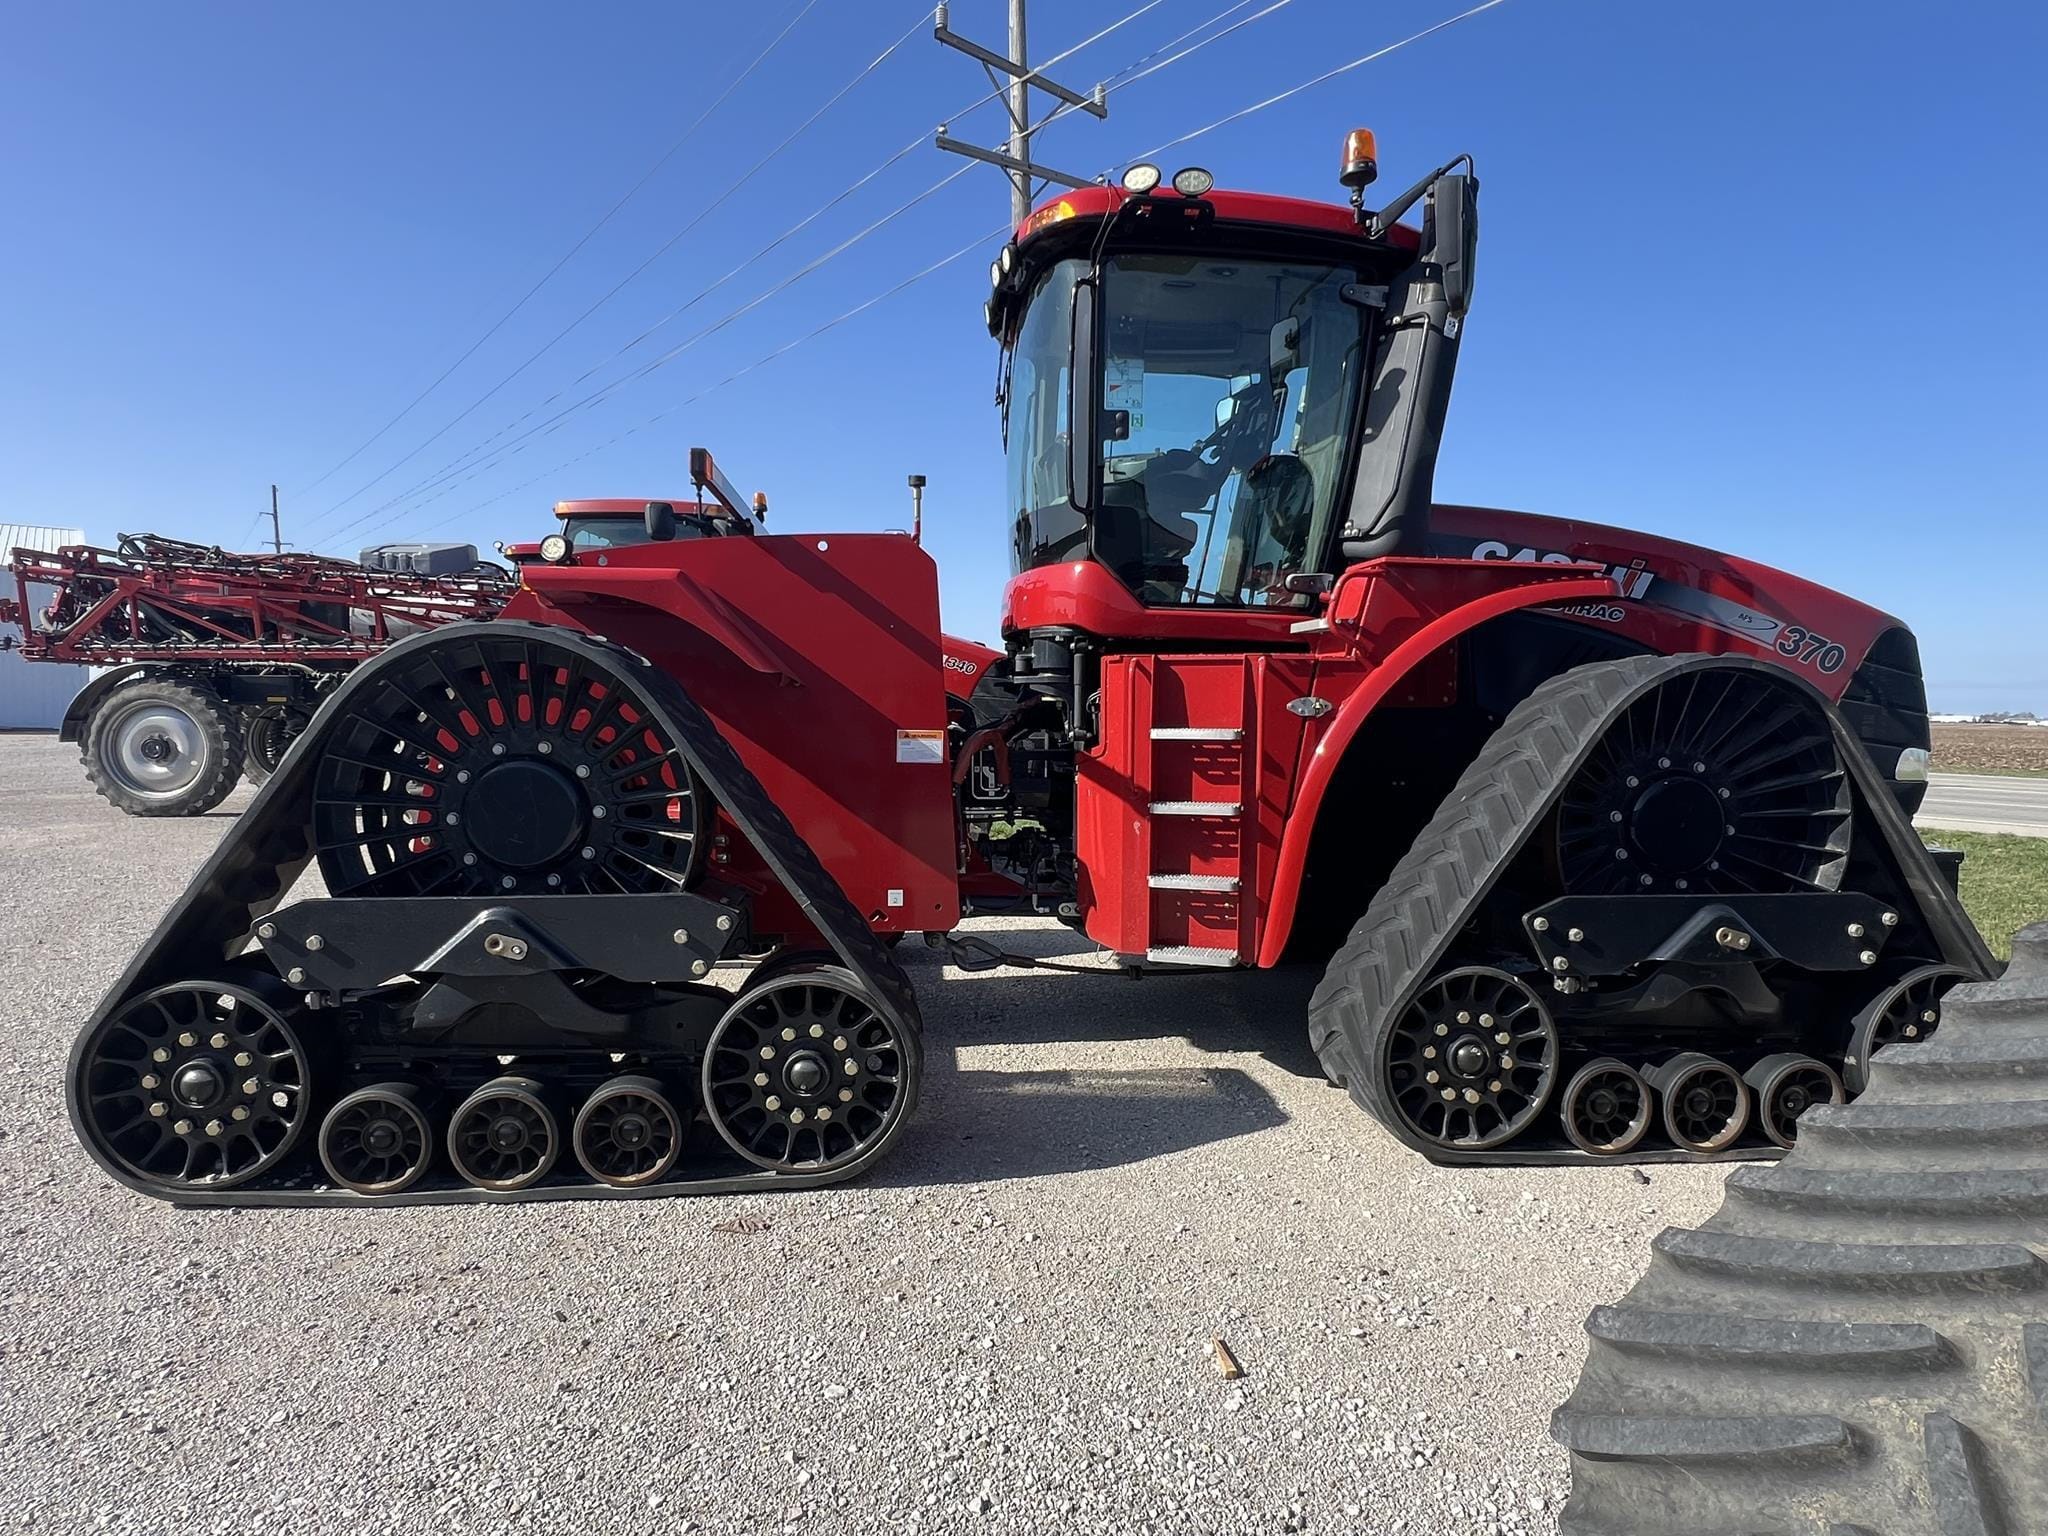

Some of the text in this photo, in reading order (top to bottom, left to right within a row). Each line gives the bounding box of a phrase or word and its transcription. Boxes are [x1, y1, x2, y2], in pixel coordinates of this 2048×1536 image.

[1543, 604, 1625, 622] TRAC
[1776, 625, 1846, 674] 370
[945, 656, 977, 675] 340
